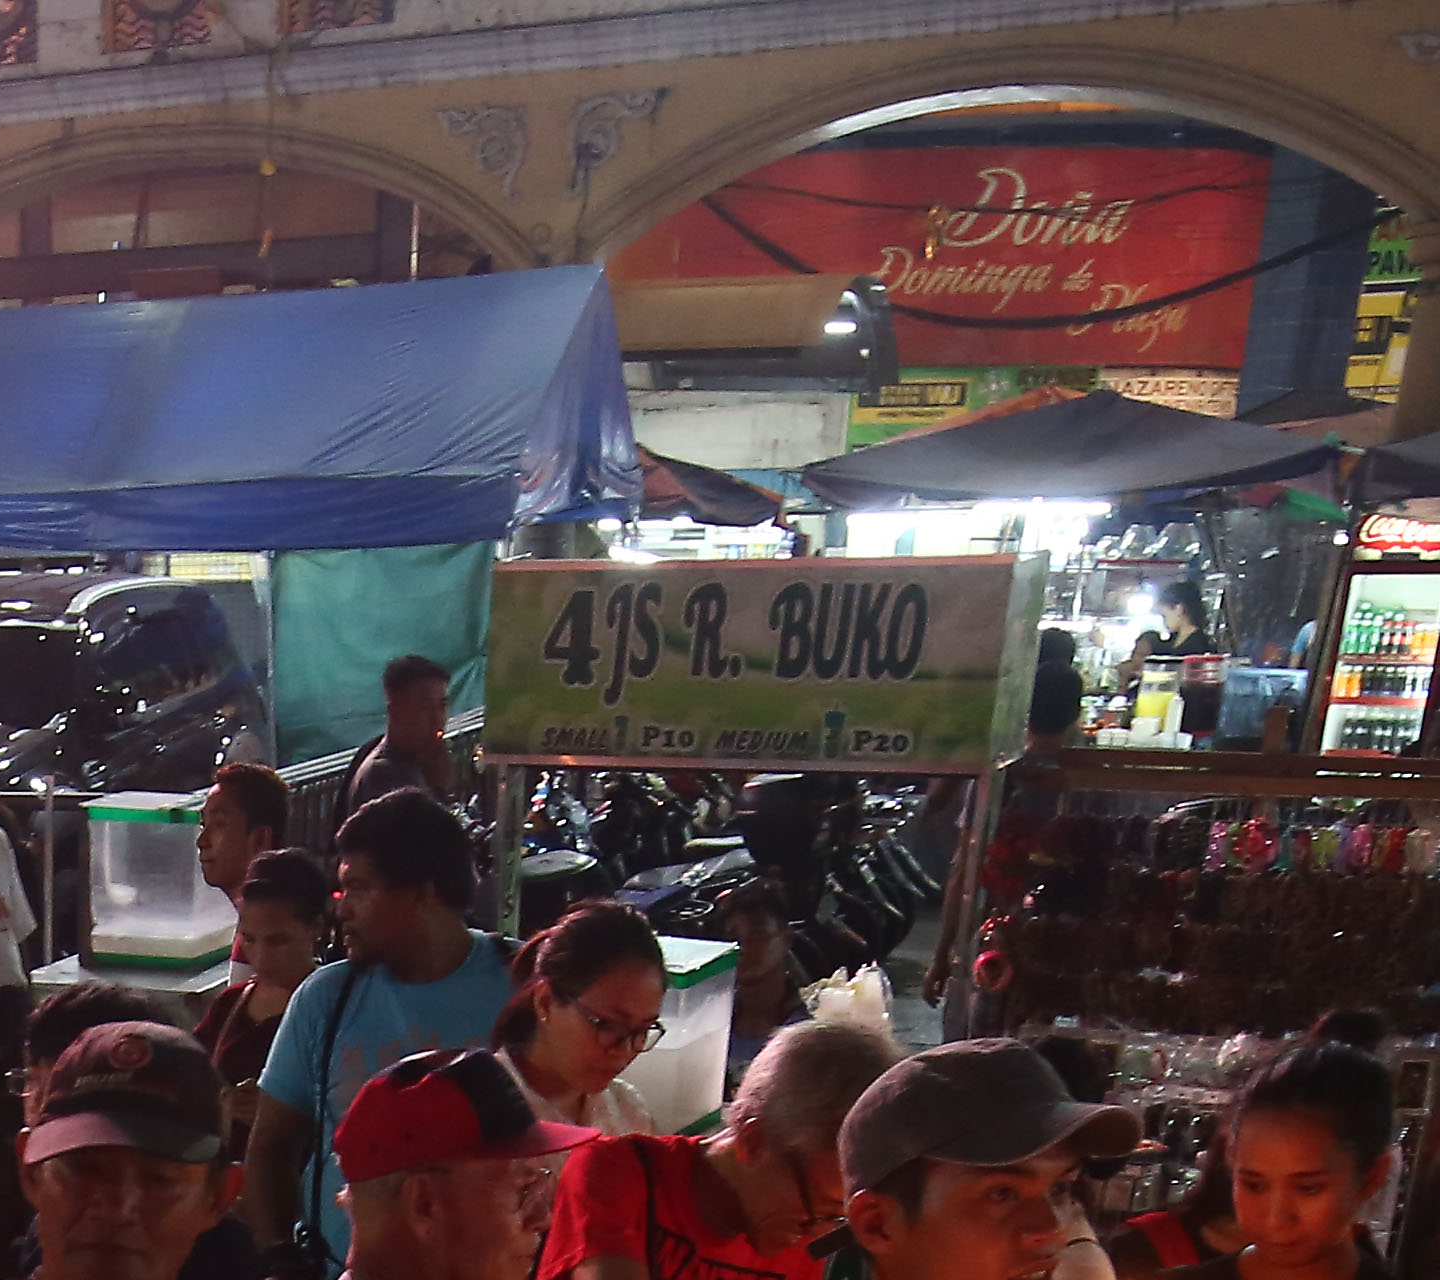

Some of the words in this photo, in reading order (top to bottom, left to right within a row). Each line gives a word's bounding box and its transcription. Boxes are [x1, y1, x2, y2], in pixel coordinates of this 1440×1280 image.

[940, 166, 1136, 247] Doña
[872, 246, 1054, 314] Dominga
[768, 582, 930, 681] BUKO
[541, 727, 608, 750] SMALL
[641, 725, 696, 749] P10
[714, 728, 812, 754] MEDIUM
[850, 729, 911, 754] P20
